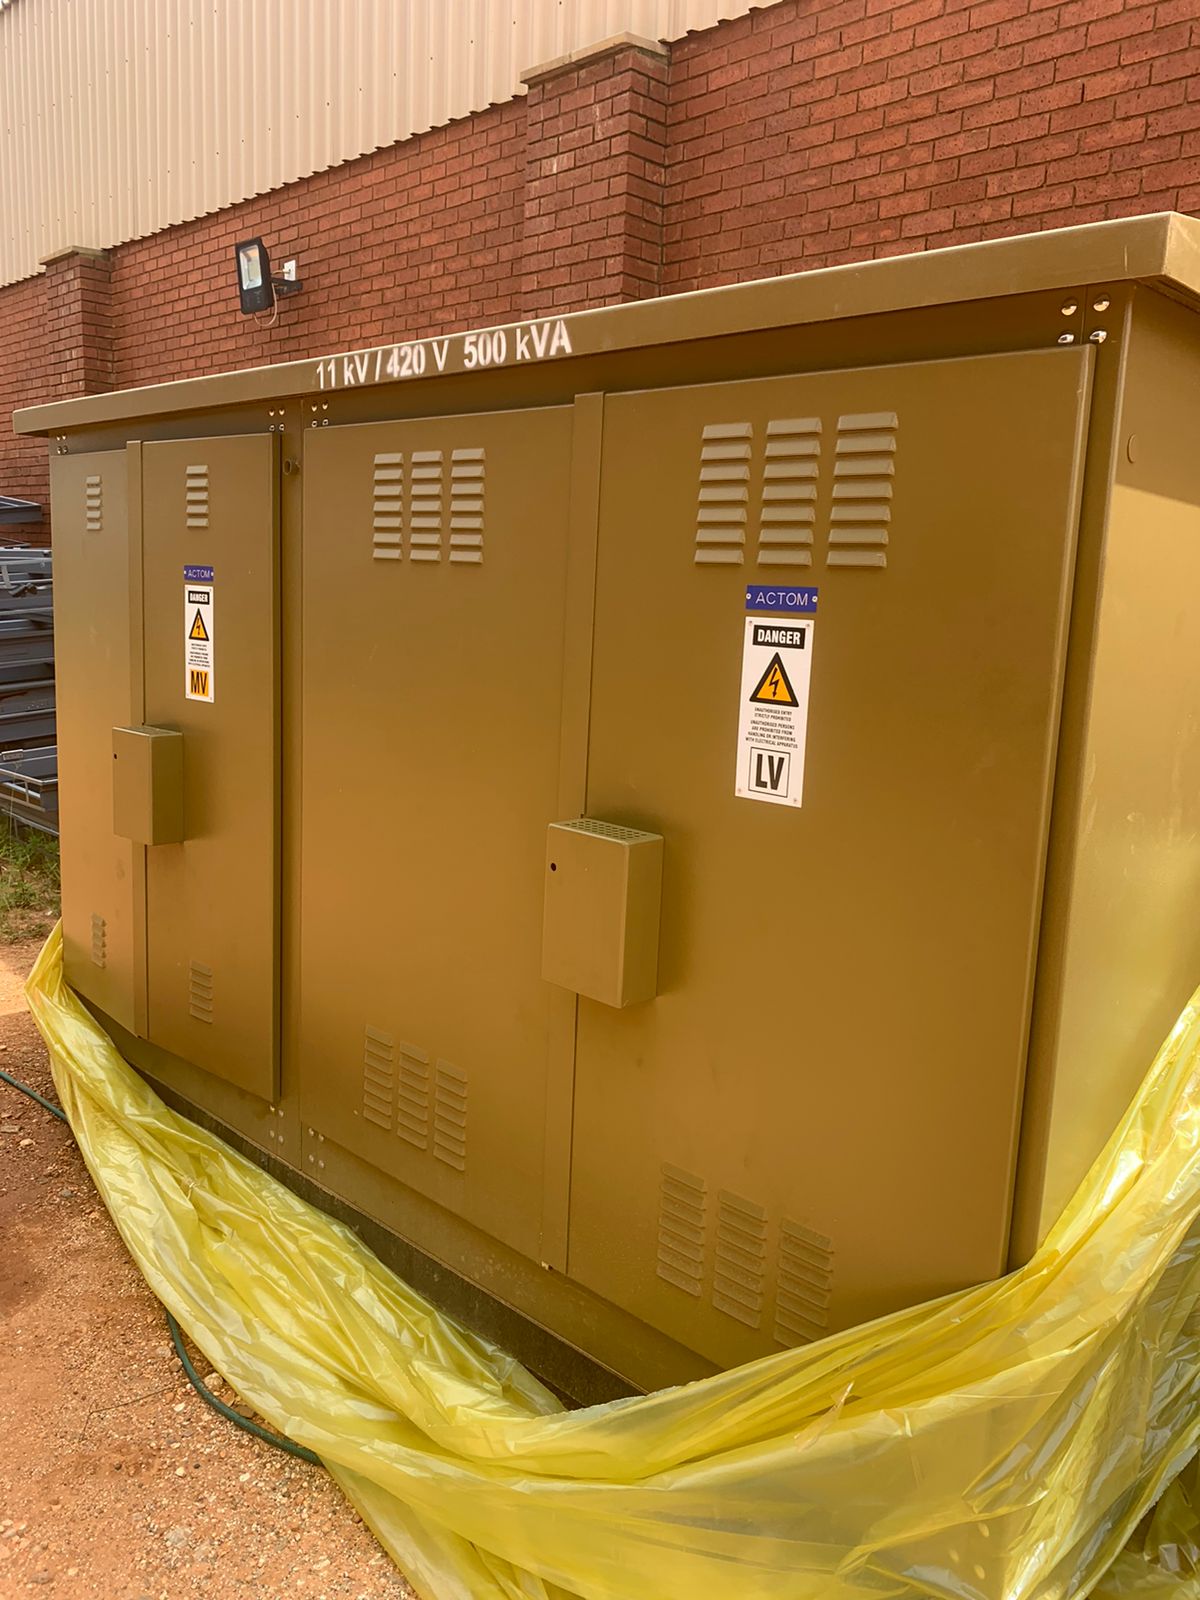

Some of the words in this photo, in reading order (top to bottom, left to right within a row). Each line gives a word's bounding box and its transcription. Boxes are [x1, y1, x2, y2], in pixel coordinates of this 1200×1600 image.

[316, 359, 336, 390] 11
[343, 352, 369, 386] kV
[386, 343, 426, 378] 420
[432, 339, 449, 372] V
[463, 330, 507, 369] 500
[516, 319, 572, 361] kVA
[188, 569, 210, 578] ACTOM
[755, 591, 808, 606] ACTOM
[757, 629, 801, 645] DANGER
[191, 670, 207, 694] MV
[755, 753, 785, 790] LV
